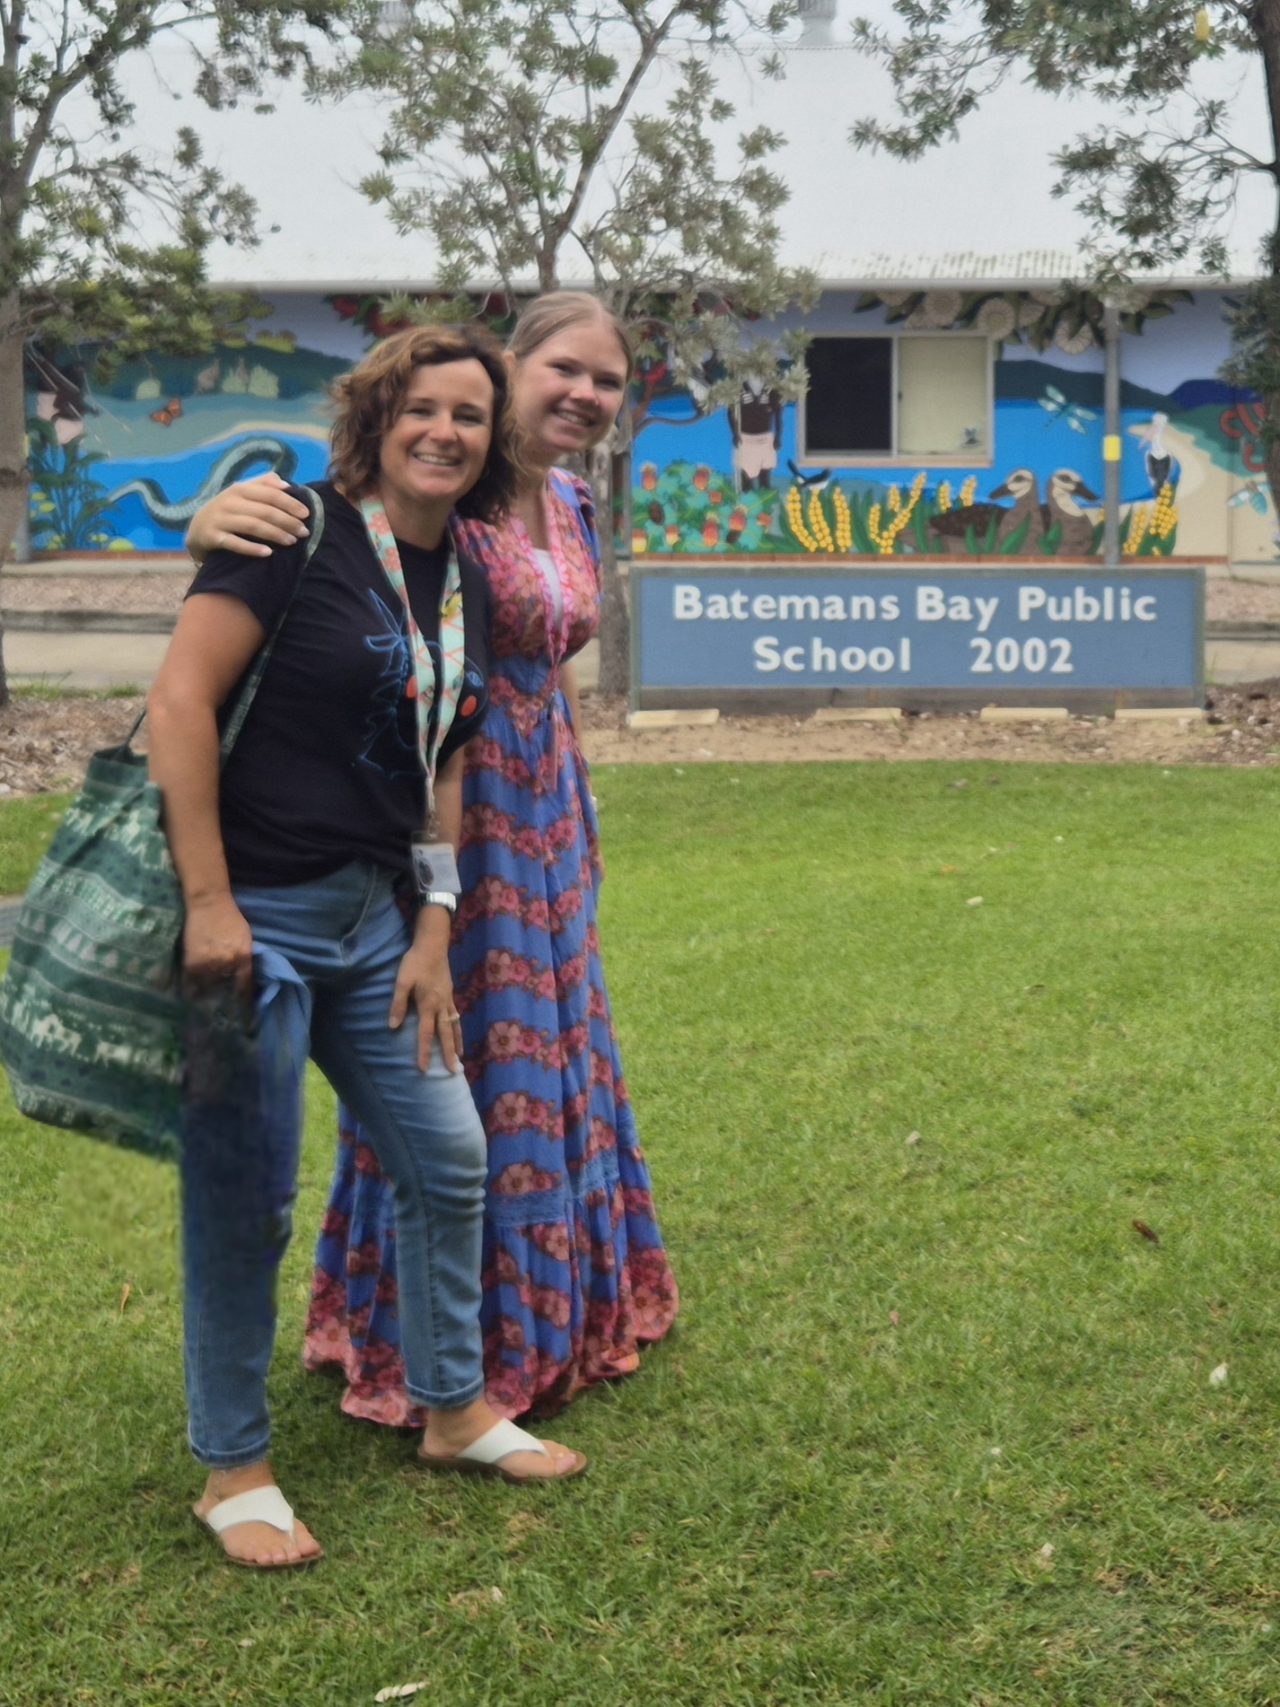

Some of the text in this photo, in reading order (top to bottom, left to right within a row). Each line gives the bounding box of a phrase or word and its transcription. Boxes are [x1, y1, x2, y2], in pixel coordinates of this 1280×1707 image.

[673, 584, 1157, 632] Batemans Bay Public
[753, 636, 1074, 674] School 2002
